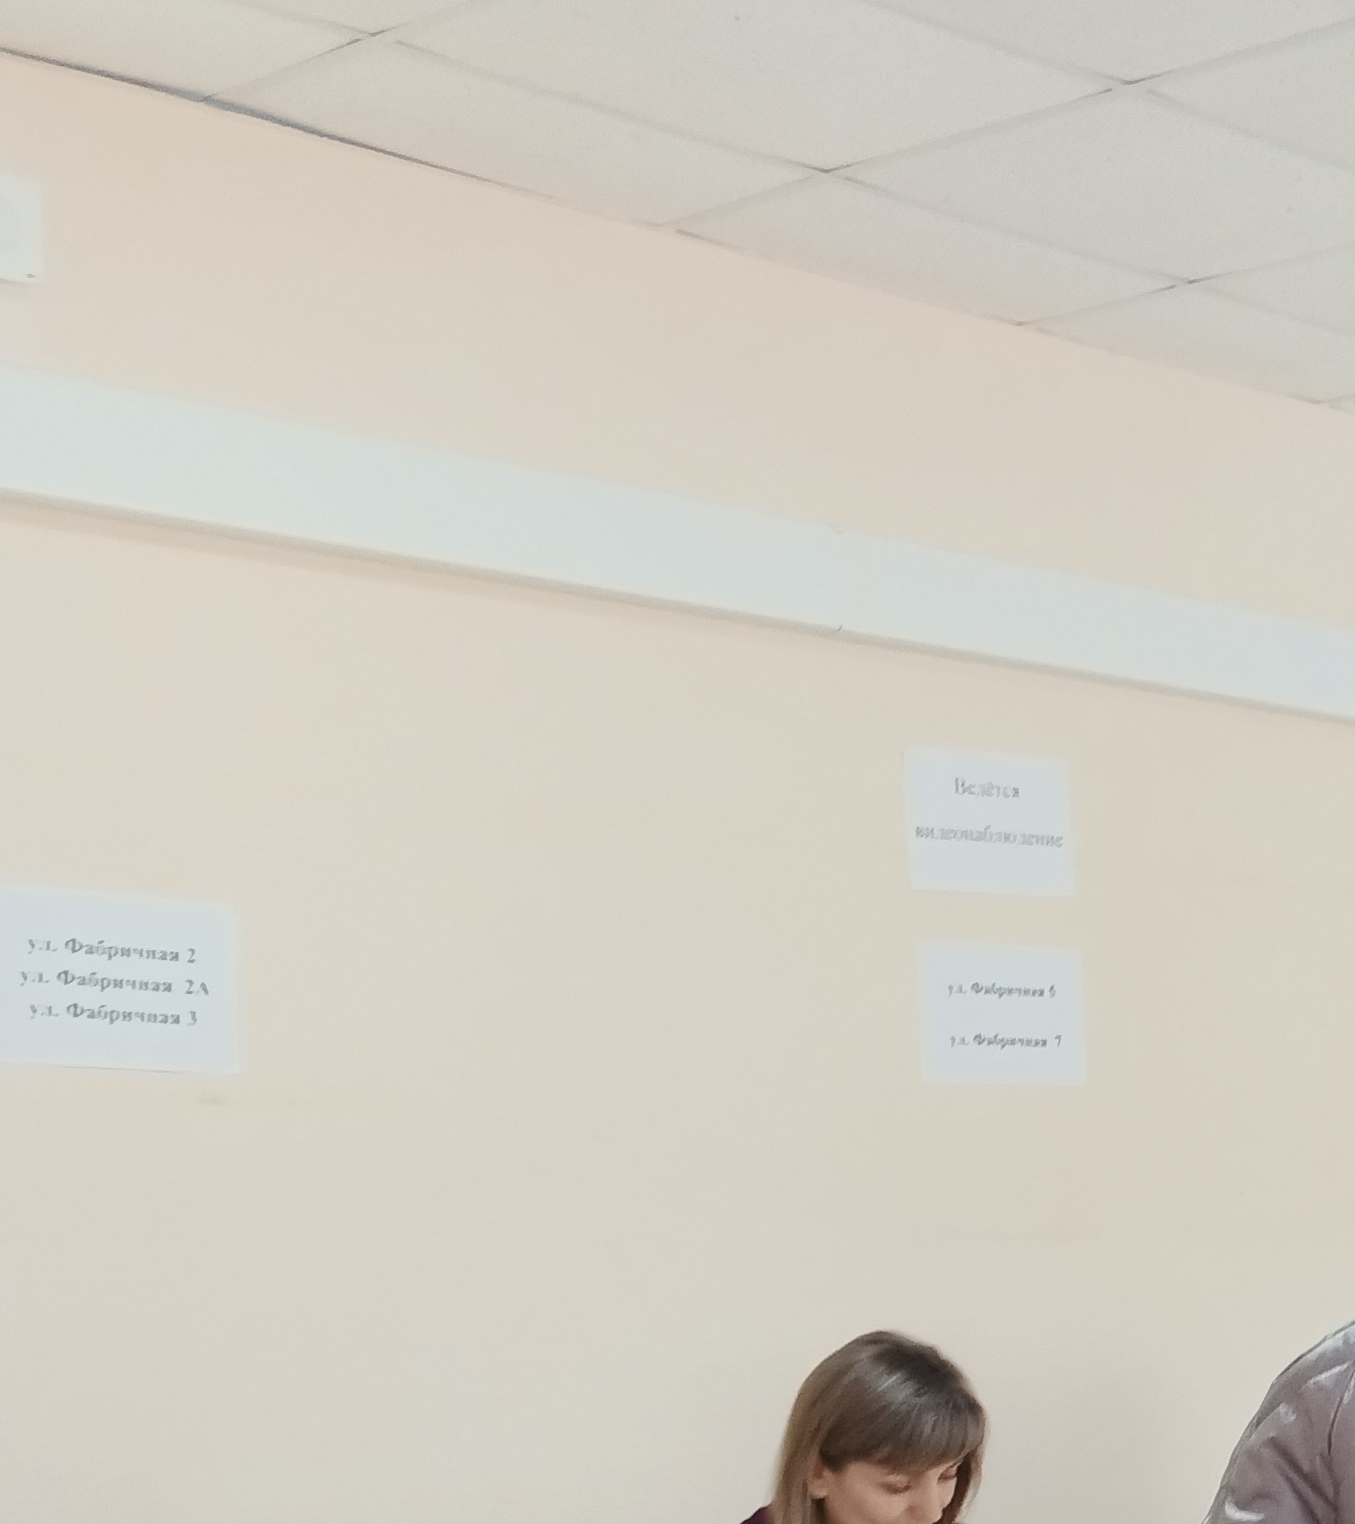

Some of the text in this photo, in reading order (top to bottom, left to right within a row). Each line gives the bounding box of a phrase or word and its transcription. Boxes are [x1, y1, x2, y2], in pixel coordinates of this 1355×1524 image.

[27, 937, 196, 964] ул. Фабричная 2
[19, 970, 50, 986] ул.
[56, 969, 173, 993] Фабричная
[29, 1002, 198, 1027] ул. Фабричная 3
